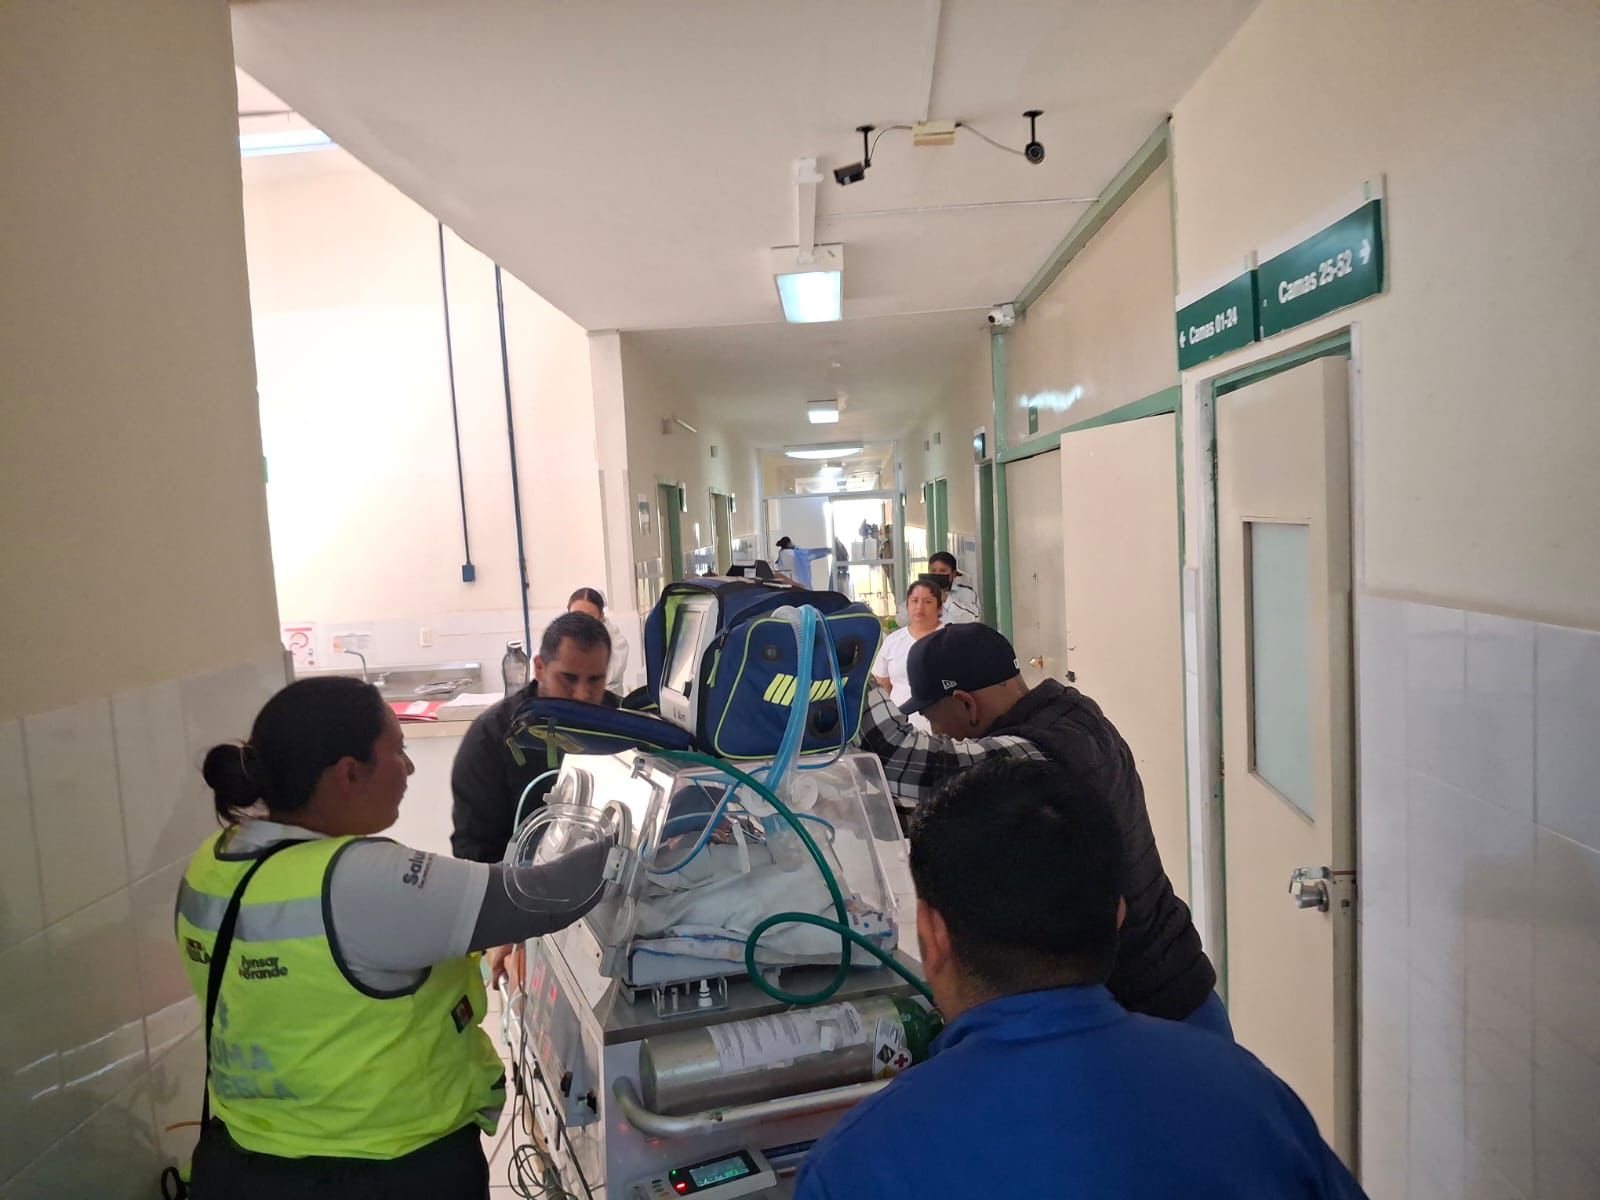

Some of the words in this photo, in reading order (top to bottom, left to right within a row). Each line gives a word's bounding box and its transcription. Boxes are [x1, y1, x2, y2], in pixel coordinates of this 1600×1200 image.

[1278, 272, 1317, 303] Camas
[1319, 249, 1353, 286] 25-52
[1189, 321, 1215, 345] Camas
[1215, 306, 1238, 333] 01-24
[402, 850, 427, 886] Salu
